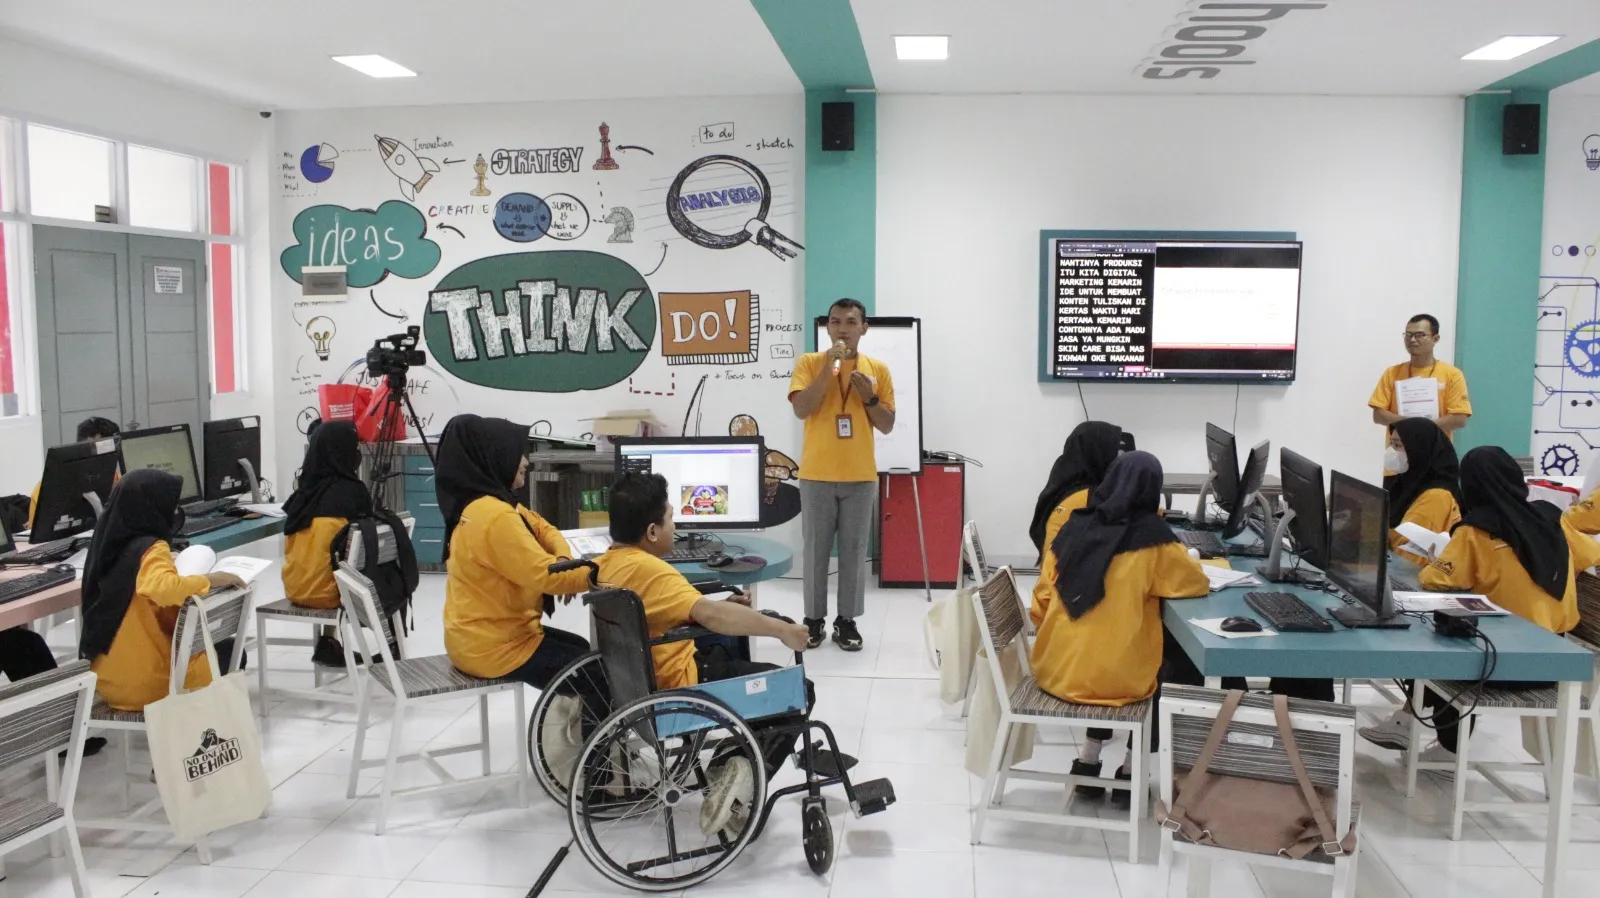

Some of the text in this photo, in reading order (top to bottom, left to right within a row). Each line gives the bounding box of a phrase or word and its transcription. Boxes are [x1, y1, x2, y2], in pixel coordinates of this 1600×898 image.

[703, 127, 732, 140] to do
[490, 146, 584, 175] STRATEGY
[679, 186, 762, 212] ANALYSIS
[428, 203, 490, 217] CREATIVE
[501, 201, 534, 213] DEMAND
[308, 211, 405, 267] ideas
[1060, 259, 1142, 267] NANTINYA PRODUKSI
[1060, 269, 1137, 277] ITU KITA DIGITAL
[1060, 288, 1142, 296] IDE UNTUK MEMBUAT
[1059, 307, 1141, 315] KERTAS WAKTU HARI
[429, 278, 651, 362] THINK
[669, 298, 738, 343] DO!
[766, 323, 803, 333] PROCESS
[1059, 326, 1145, 334] CONTOHNYA ADA MADU
[1058, 345, 1144, 353] SKIN CARE BISA MAS
[356, 368, 431, 394] JUS AKE
[725, 370, 746, 380] Focus
[186, 757, 200, 767] NO
[219, 740, 236, 751] EFT
[188, 747, 239, 779] BEHIND
